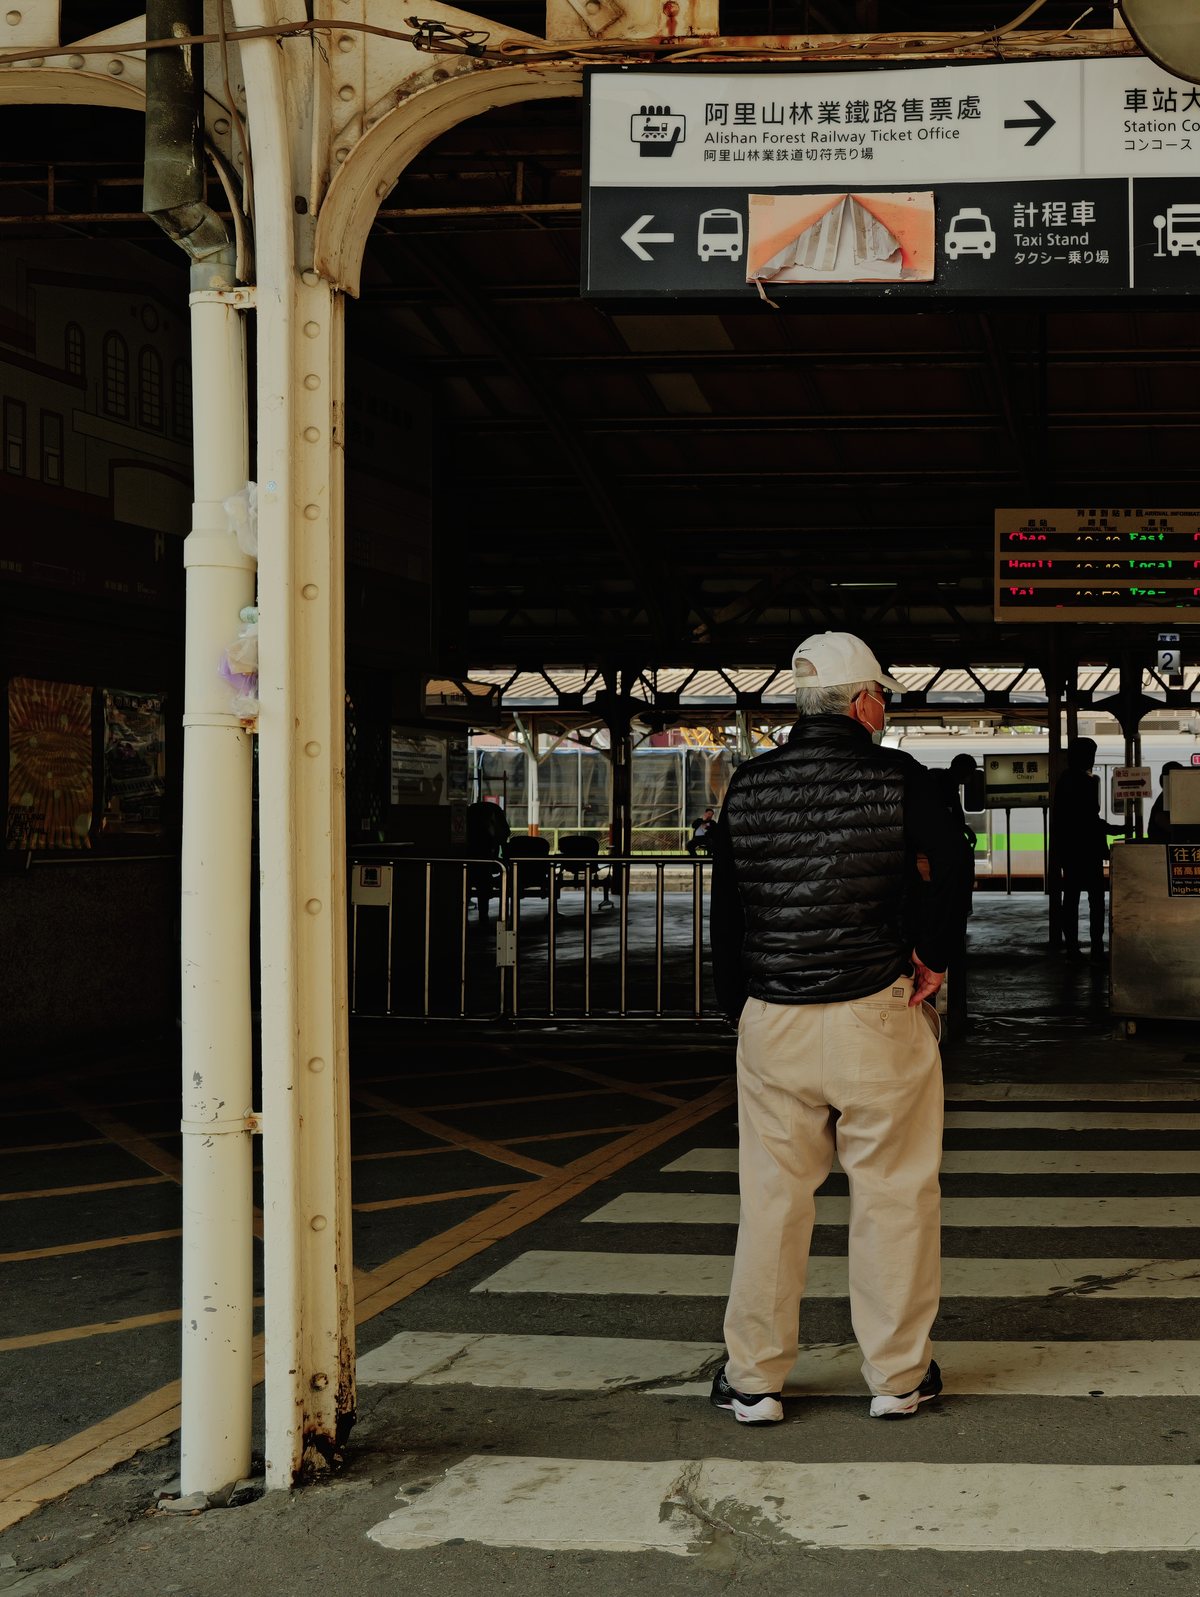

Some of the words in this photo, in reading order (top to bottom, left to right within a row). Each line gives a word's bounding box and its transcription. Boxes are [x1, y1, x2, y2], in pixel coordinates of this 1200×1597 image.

[703, 94, 983, 127] 阿里山林業鐵路售票處
[1123, 119, 1178, 133] Station
[704, 131, 757, 144] Alishan
[762, 131, 806, 144] Forest
[810, 130, 866, 146] Railway
[870, 128, 913, 142] Ticket
[917, 126, 960, 141] Office
[1124, 138, 1193, 152] コンコース
[703, 147, 874, 162] 阿里山林業鉄道切符売り場
[1013, 199, 1097, 228] 計程車
[1013, 232, 1042, 247] Taxi
[1046, 231, 1089, 247] Stand
[1014, 249, 1110, 265] タクシー乗り場
[1162, 652, 1173, 670] 2
